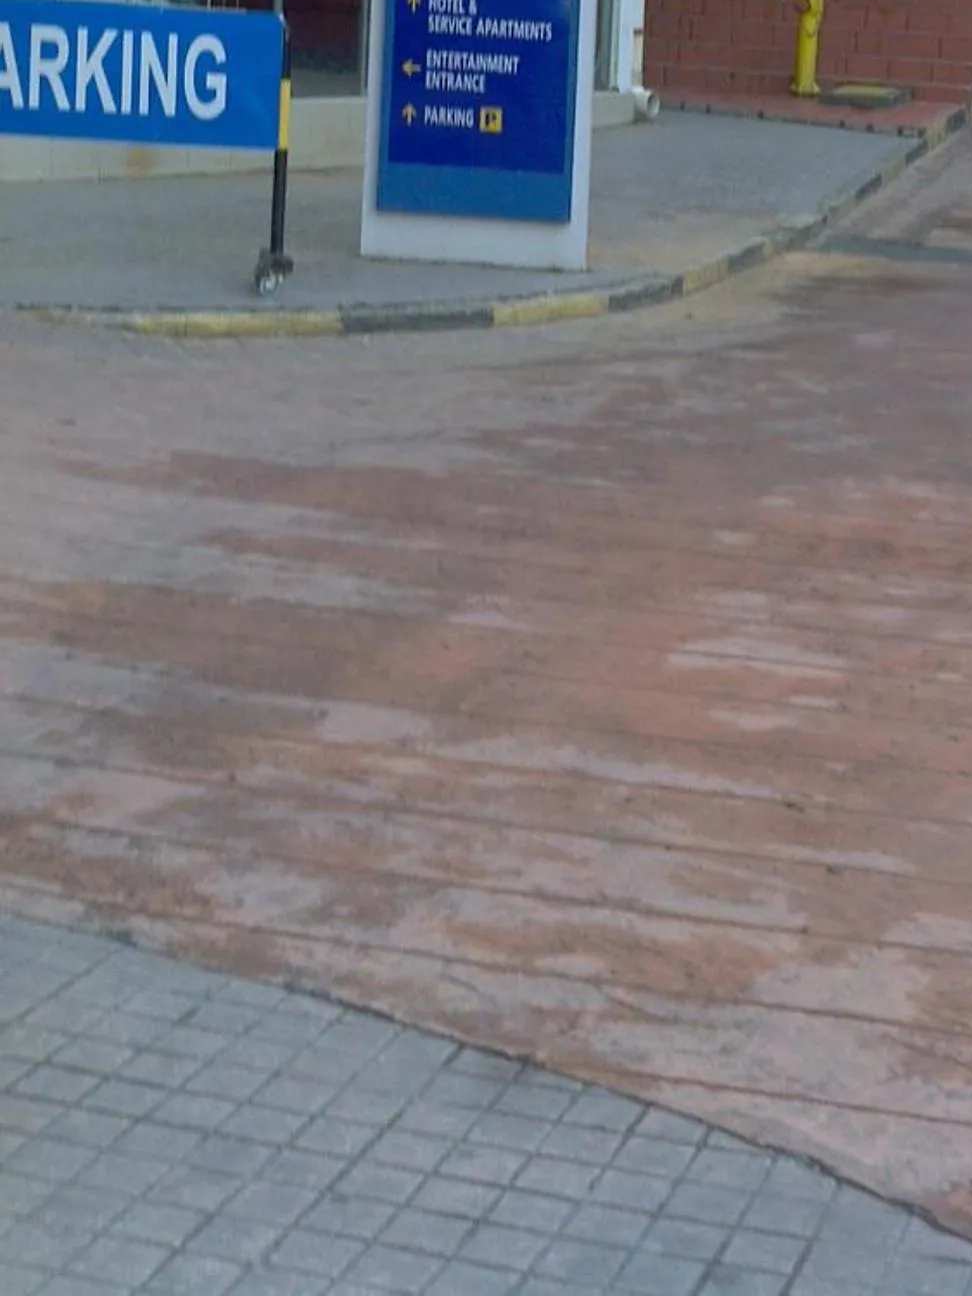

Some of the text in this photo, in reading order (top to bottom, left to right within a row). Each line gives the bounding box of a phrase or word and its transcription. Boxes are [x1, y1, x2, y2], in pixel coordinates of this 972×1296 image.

[428, 15, 553, 43] SERVICE APARTMENTS
[426, 49, 521, 75] ENTERTAINMENT
[425, 71, 486, 94] ENTRANCE
[423, 105, 474, 129] PARKING
